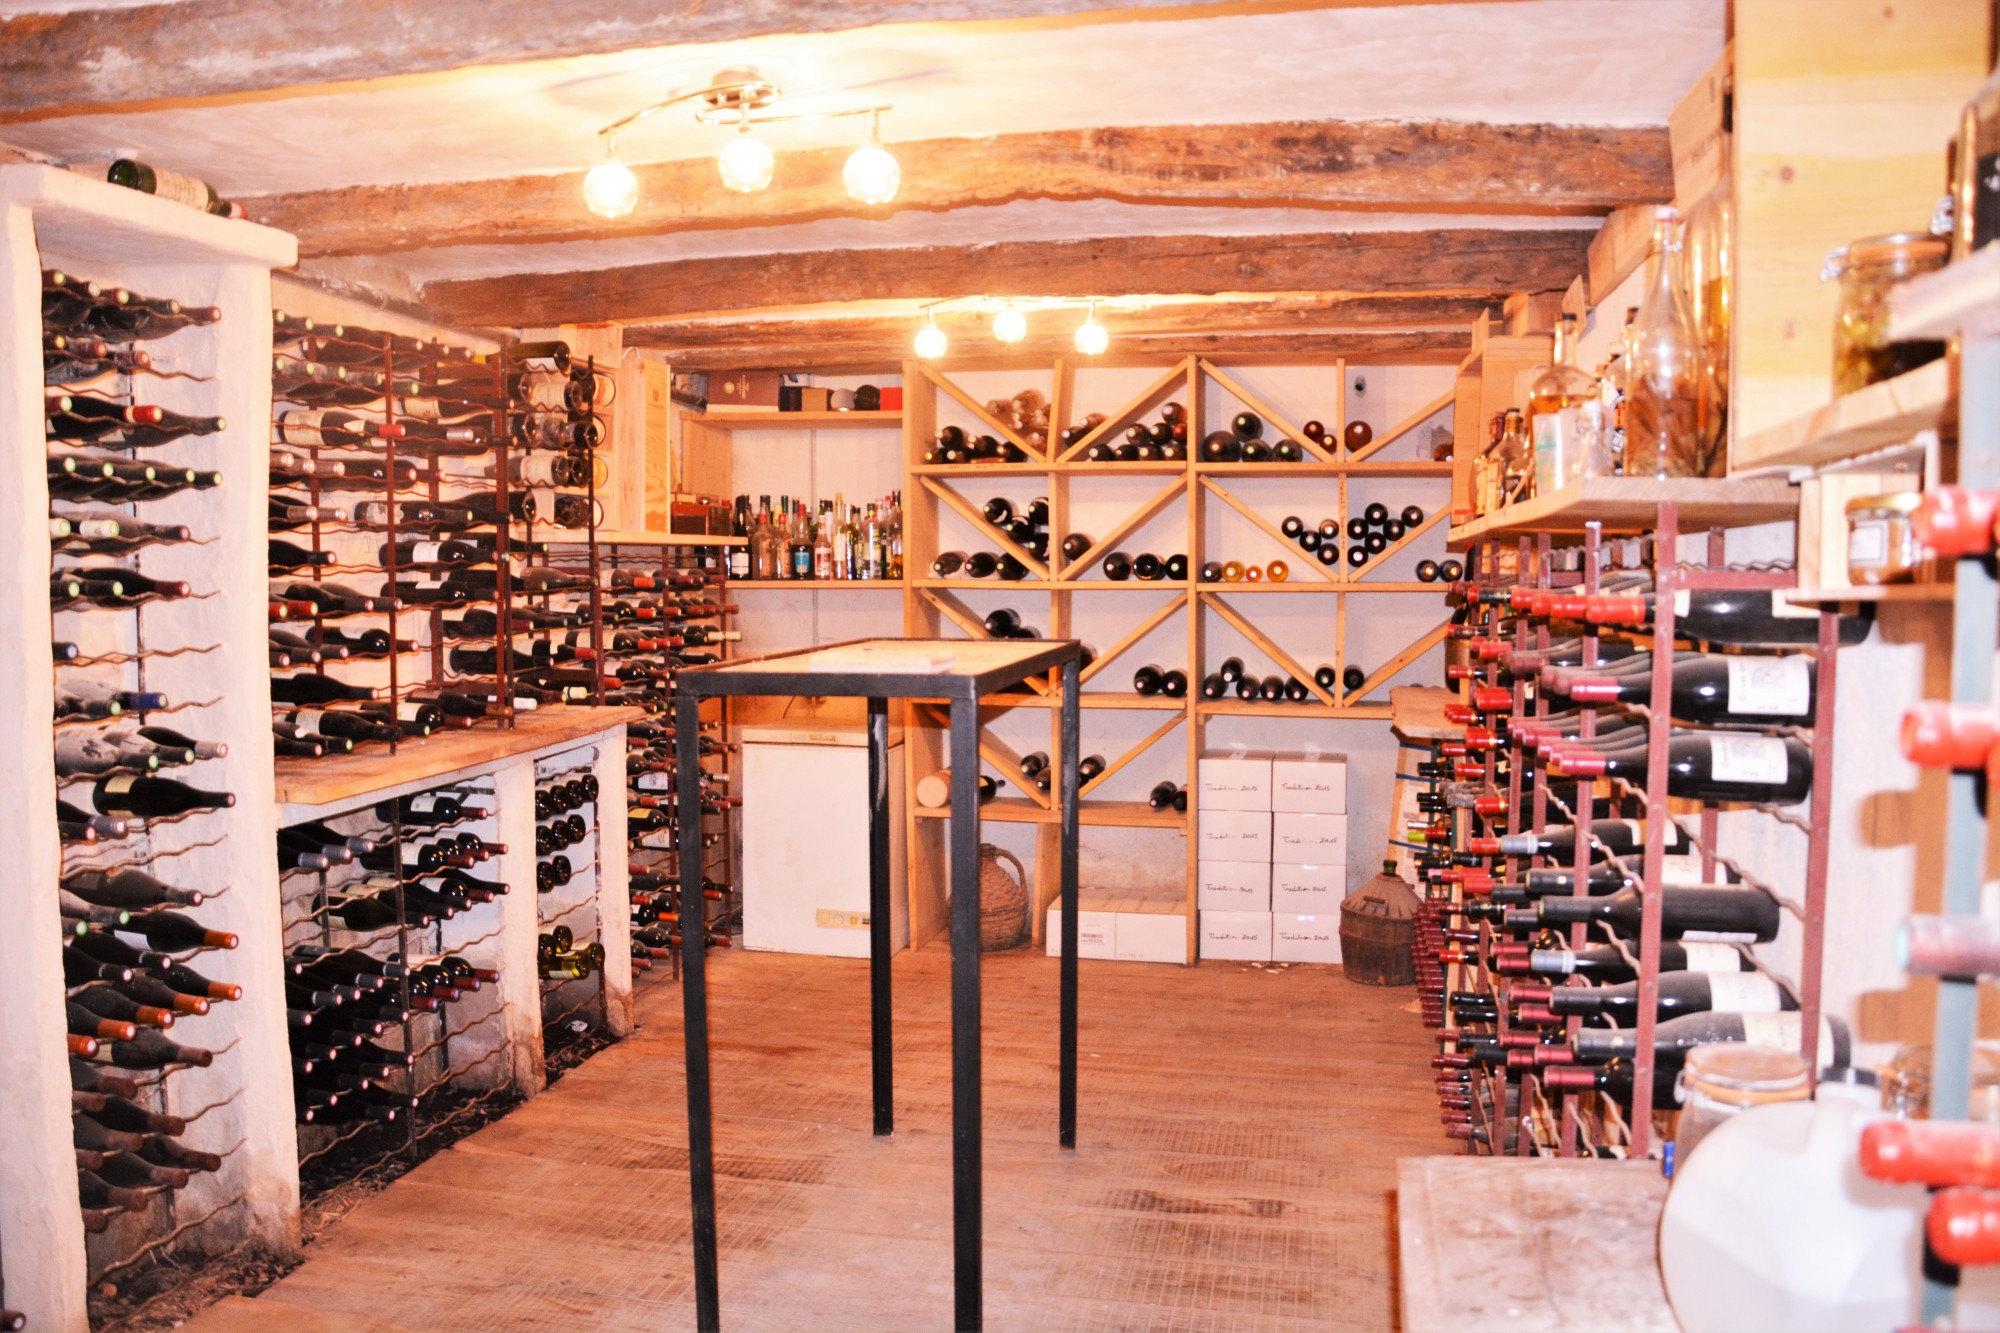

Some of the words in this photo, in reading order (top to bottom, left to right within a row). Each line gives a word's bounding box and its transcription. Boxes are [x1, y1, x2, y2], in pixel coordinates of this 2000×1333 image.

[1281, 782, 1313, 791] Tradition
[1280, 883, 1311, 891] Tradition
[1279, 932, 1312, 940] Tradition
